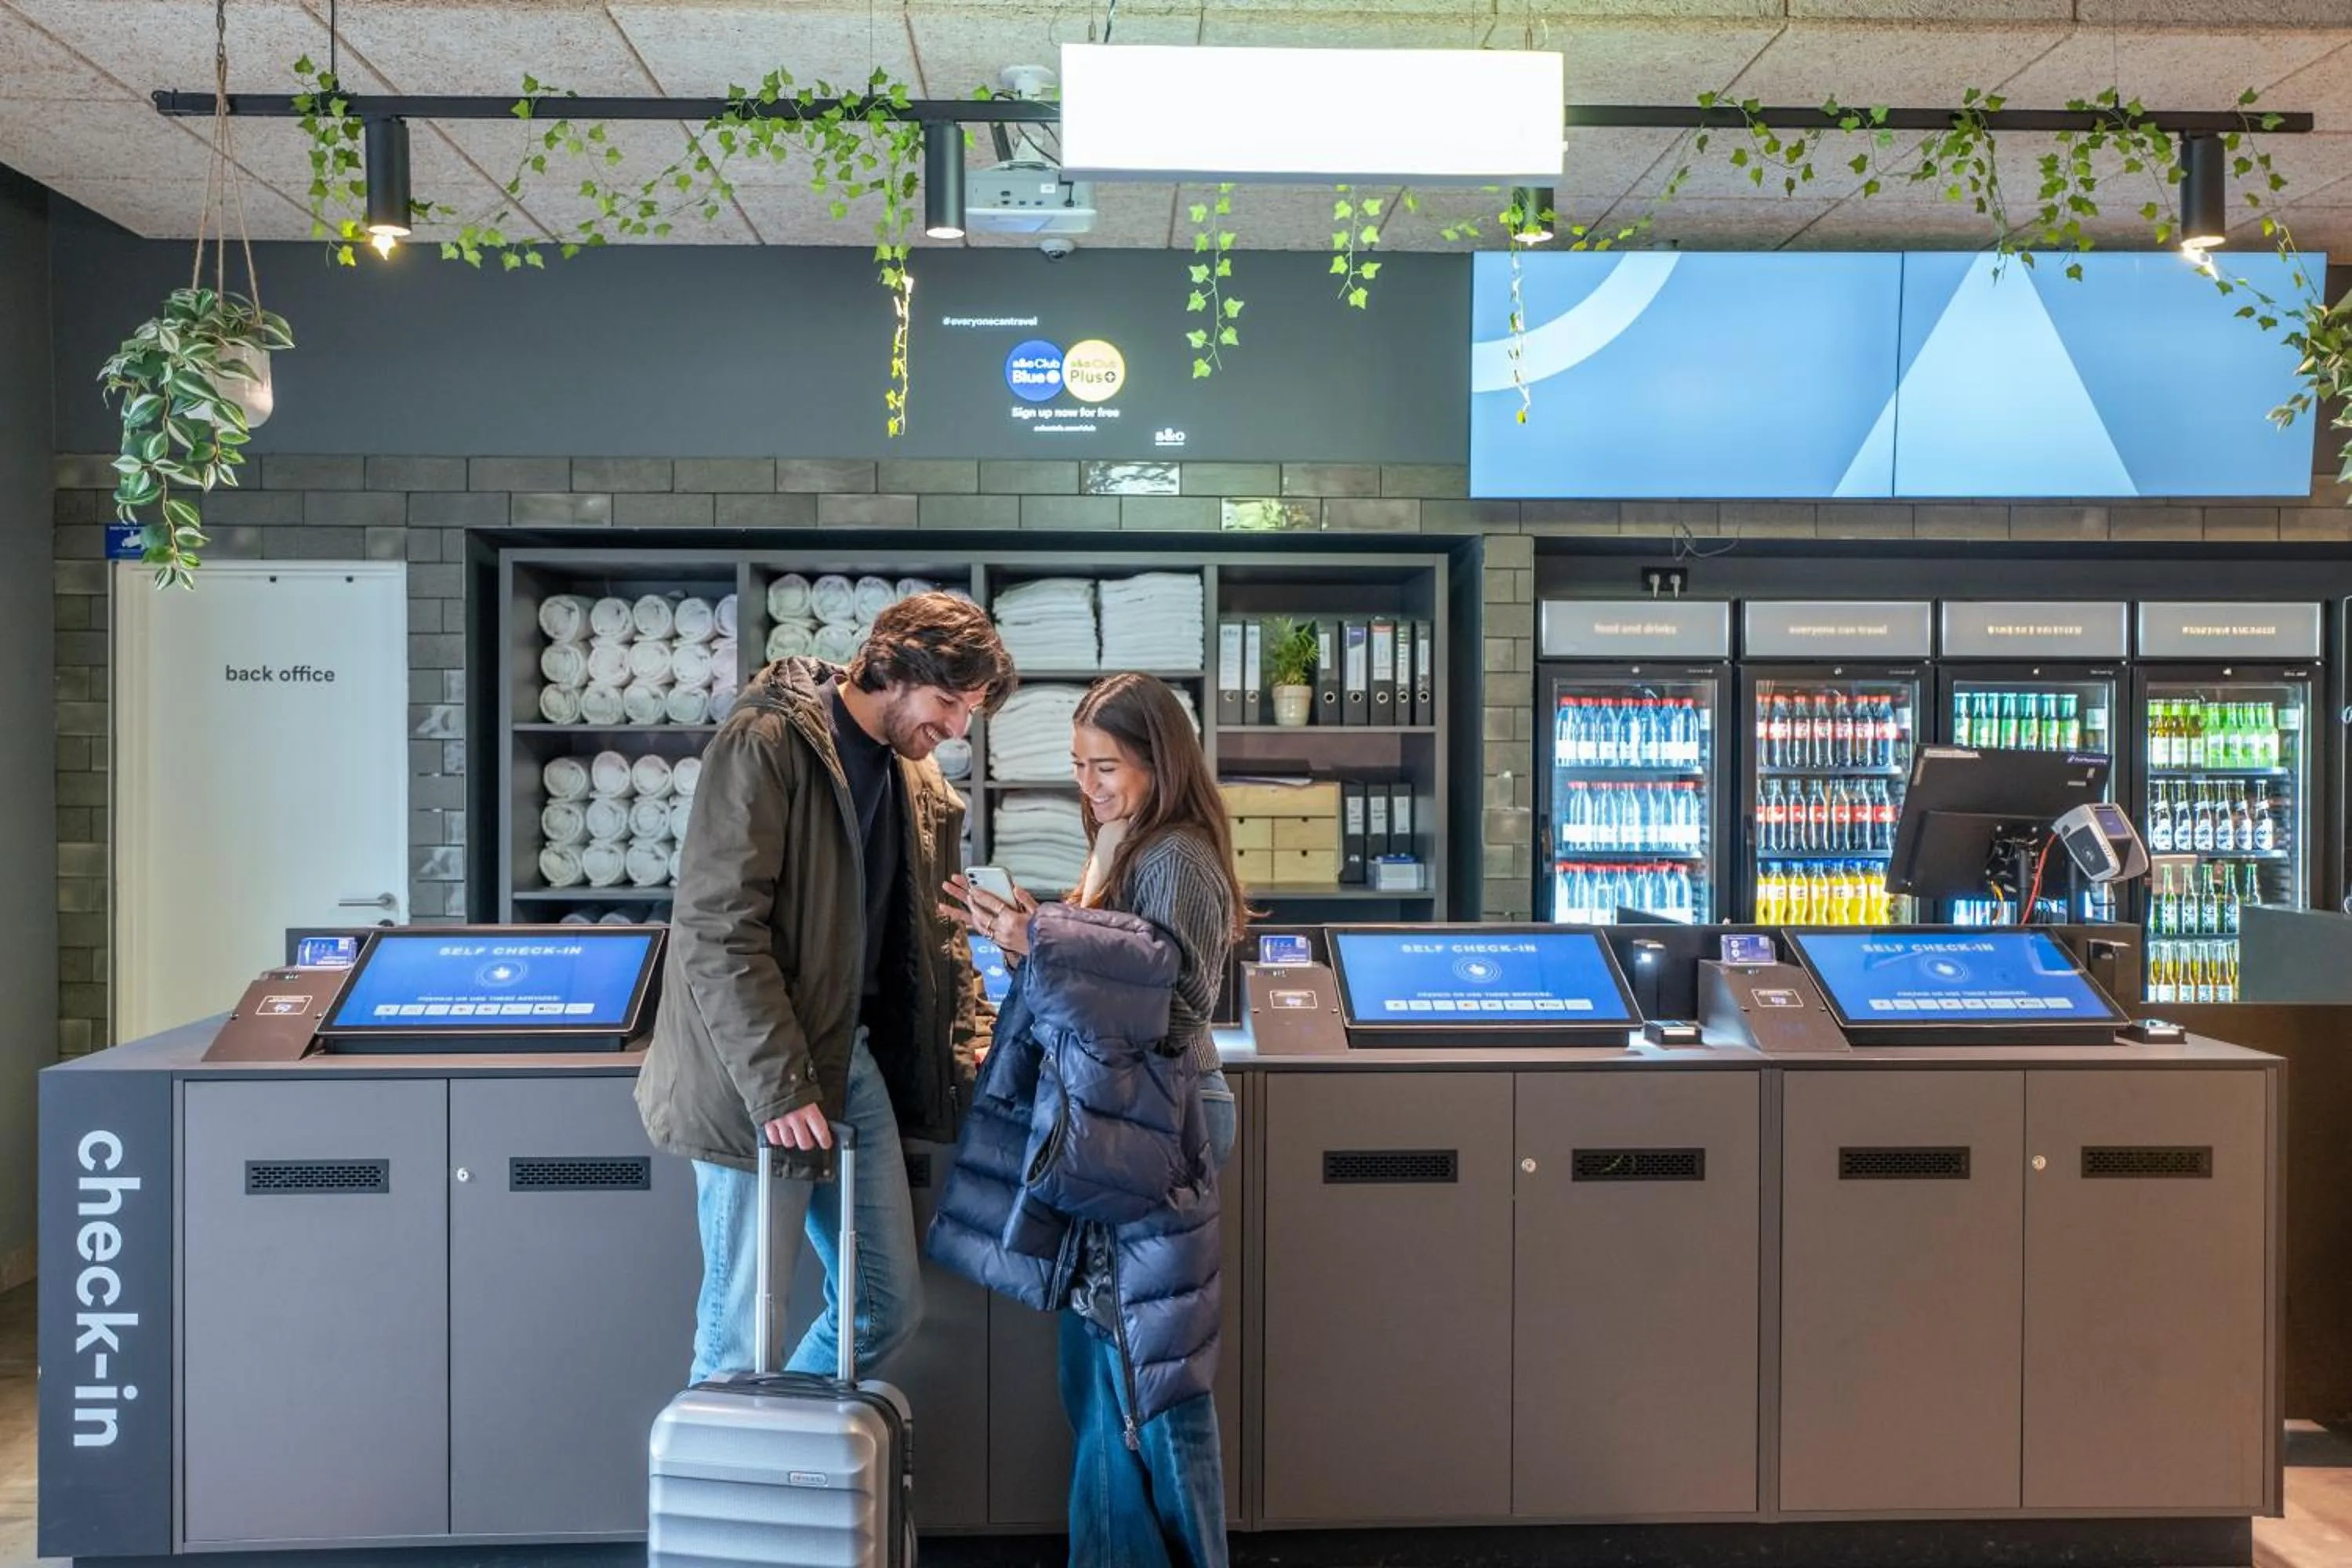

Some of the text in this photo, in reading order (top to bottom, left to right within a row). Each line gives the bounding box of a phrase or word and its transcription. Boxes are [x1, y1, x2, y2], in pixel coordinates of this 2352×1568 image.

[1035, 358, 1060, 369] Club
[1012, 369, 1045, 383] Blue
[1070, 369, 1103, 383] Plus
[1011, 407, 1120, 419] Sign up now for free
[225, 664, 335, 681] back office
[439, 946, 583, 956] SELF CHECK-IN
[1402, 944, 1537, 953] SELF CHECK-IN
[1861, 943, 1994, 952] SELF CHECK-IN
[73, 1129, 142, 1446] check-in
